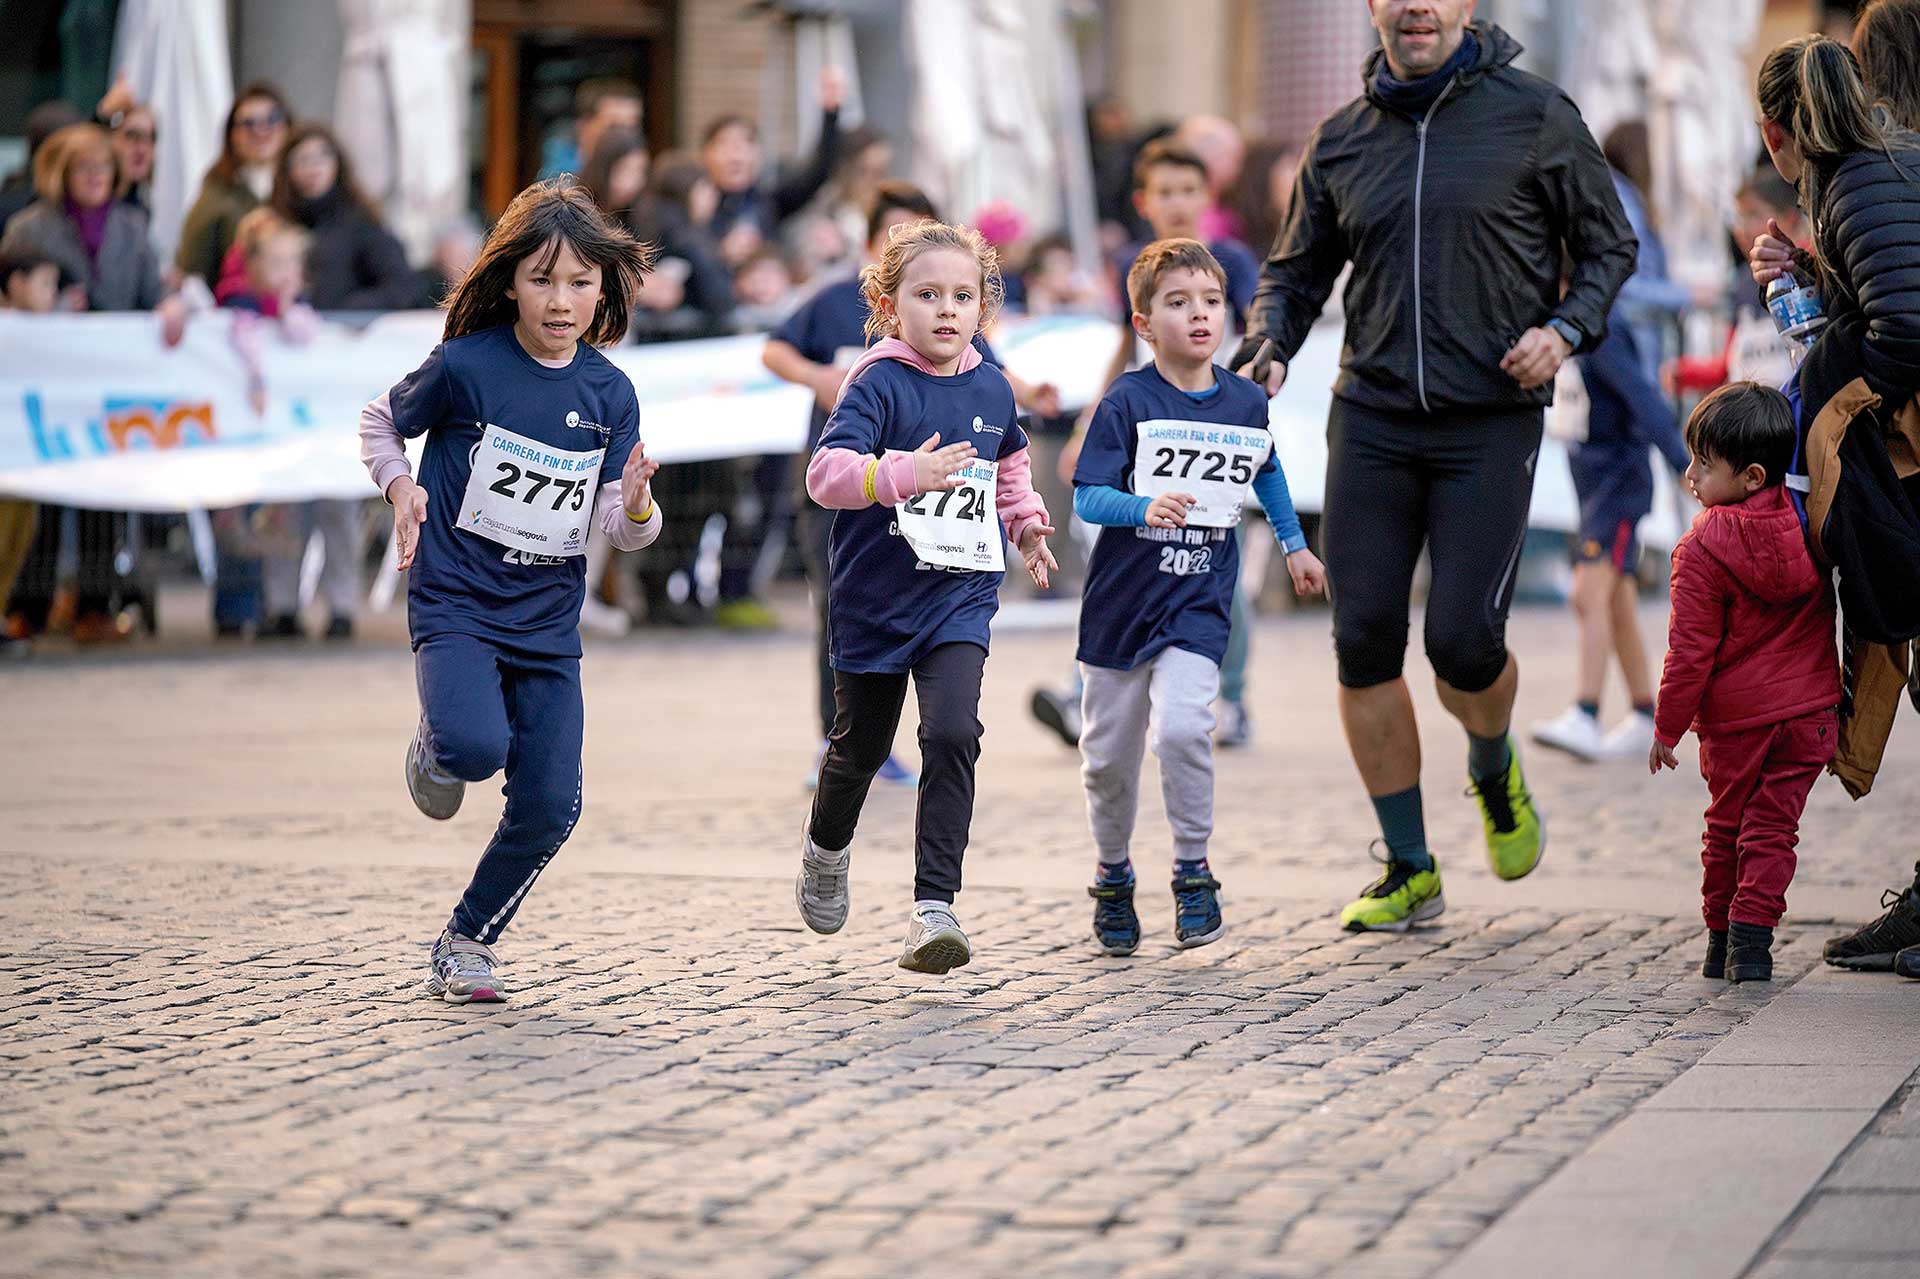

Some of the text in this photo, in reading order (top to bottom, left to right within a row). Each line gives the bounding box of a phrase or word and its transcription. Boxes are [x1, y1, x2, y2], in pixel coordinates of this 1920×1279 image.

[492, 436, 540, 463] CARRERA
[543, 454, 561, 469] FIN
[562, 458, 574, 471] DE
[1148, 427, 1266, 449] CARRERA FIN DE AÑO 2022
[1152, 447, 1253, 485] 2725
[489, 461, 588, 512] 2775
[904, 486, 986, 523] 2724
[1135, 526, 1183, 542] CARRERA
[1185, 529, 1204, 545] FIN
[1159, 546, 1213, 577] 2022
